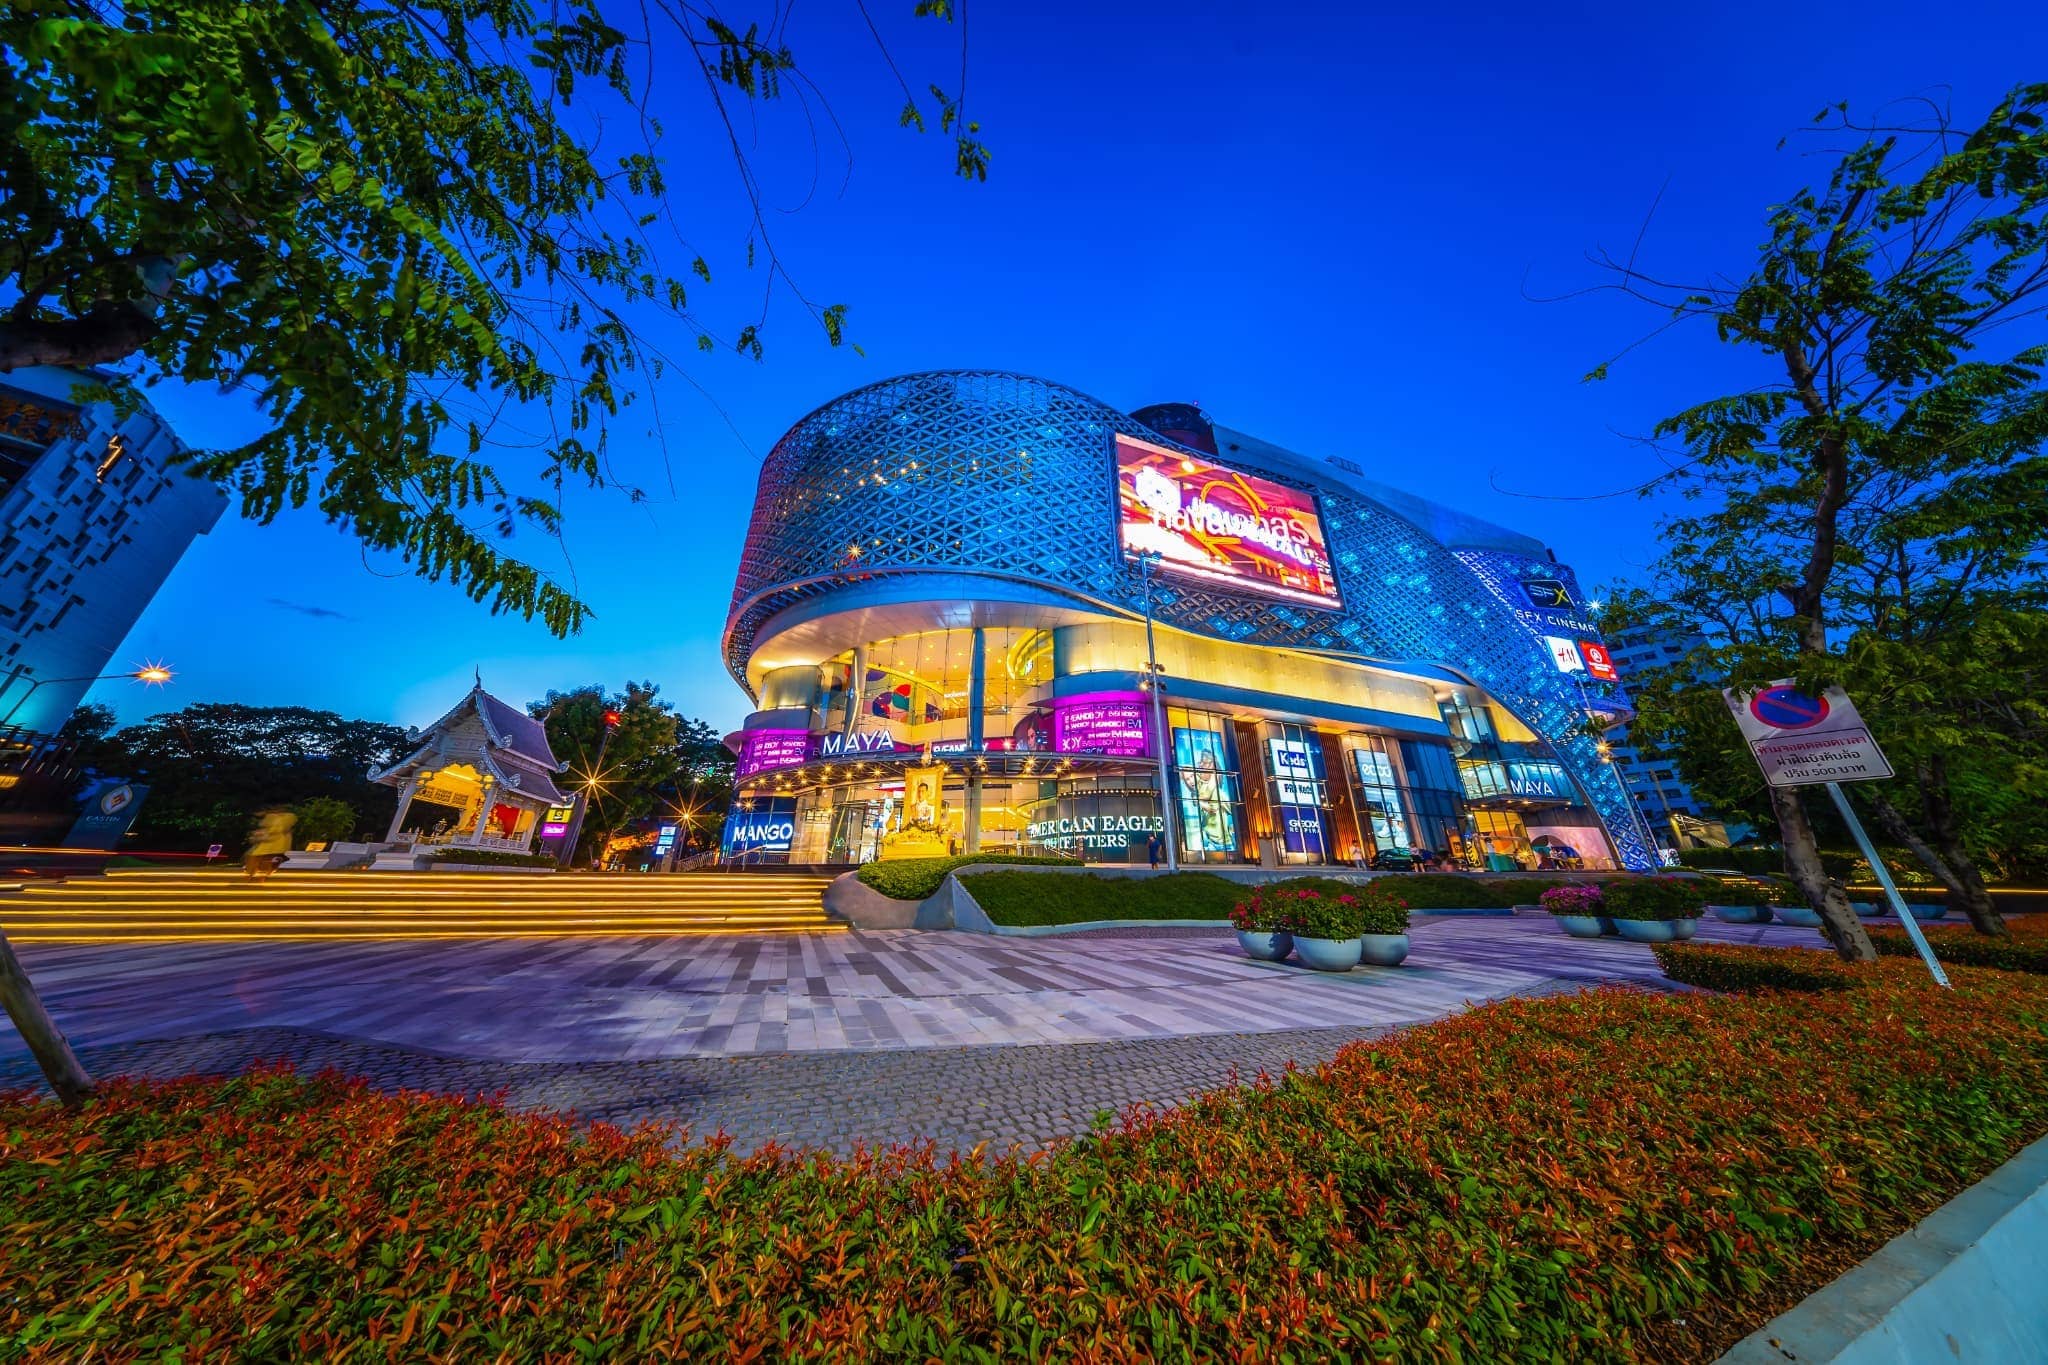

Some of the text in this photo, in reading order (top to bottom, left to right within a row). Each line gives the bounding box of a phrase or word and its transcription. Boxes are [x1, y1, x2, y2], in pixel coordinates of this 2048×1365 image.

[1515, 609, 1596, 633] SFX CINEMA
[823, 730, 894, 754] MAYA
[1362, 763, 1392, 778] ecco
[1812, 768, 1837, 776] 500
[1840, 764, 1867, 774] บาท
[1510, 779, 1554, 795] MAYA
[1101, 815, 1164, 832] EAGLE
[1288, 819, 1320, 829] GEOX
[733, 823, 794, 841] MANGO
